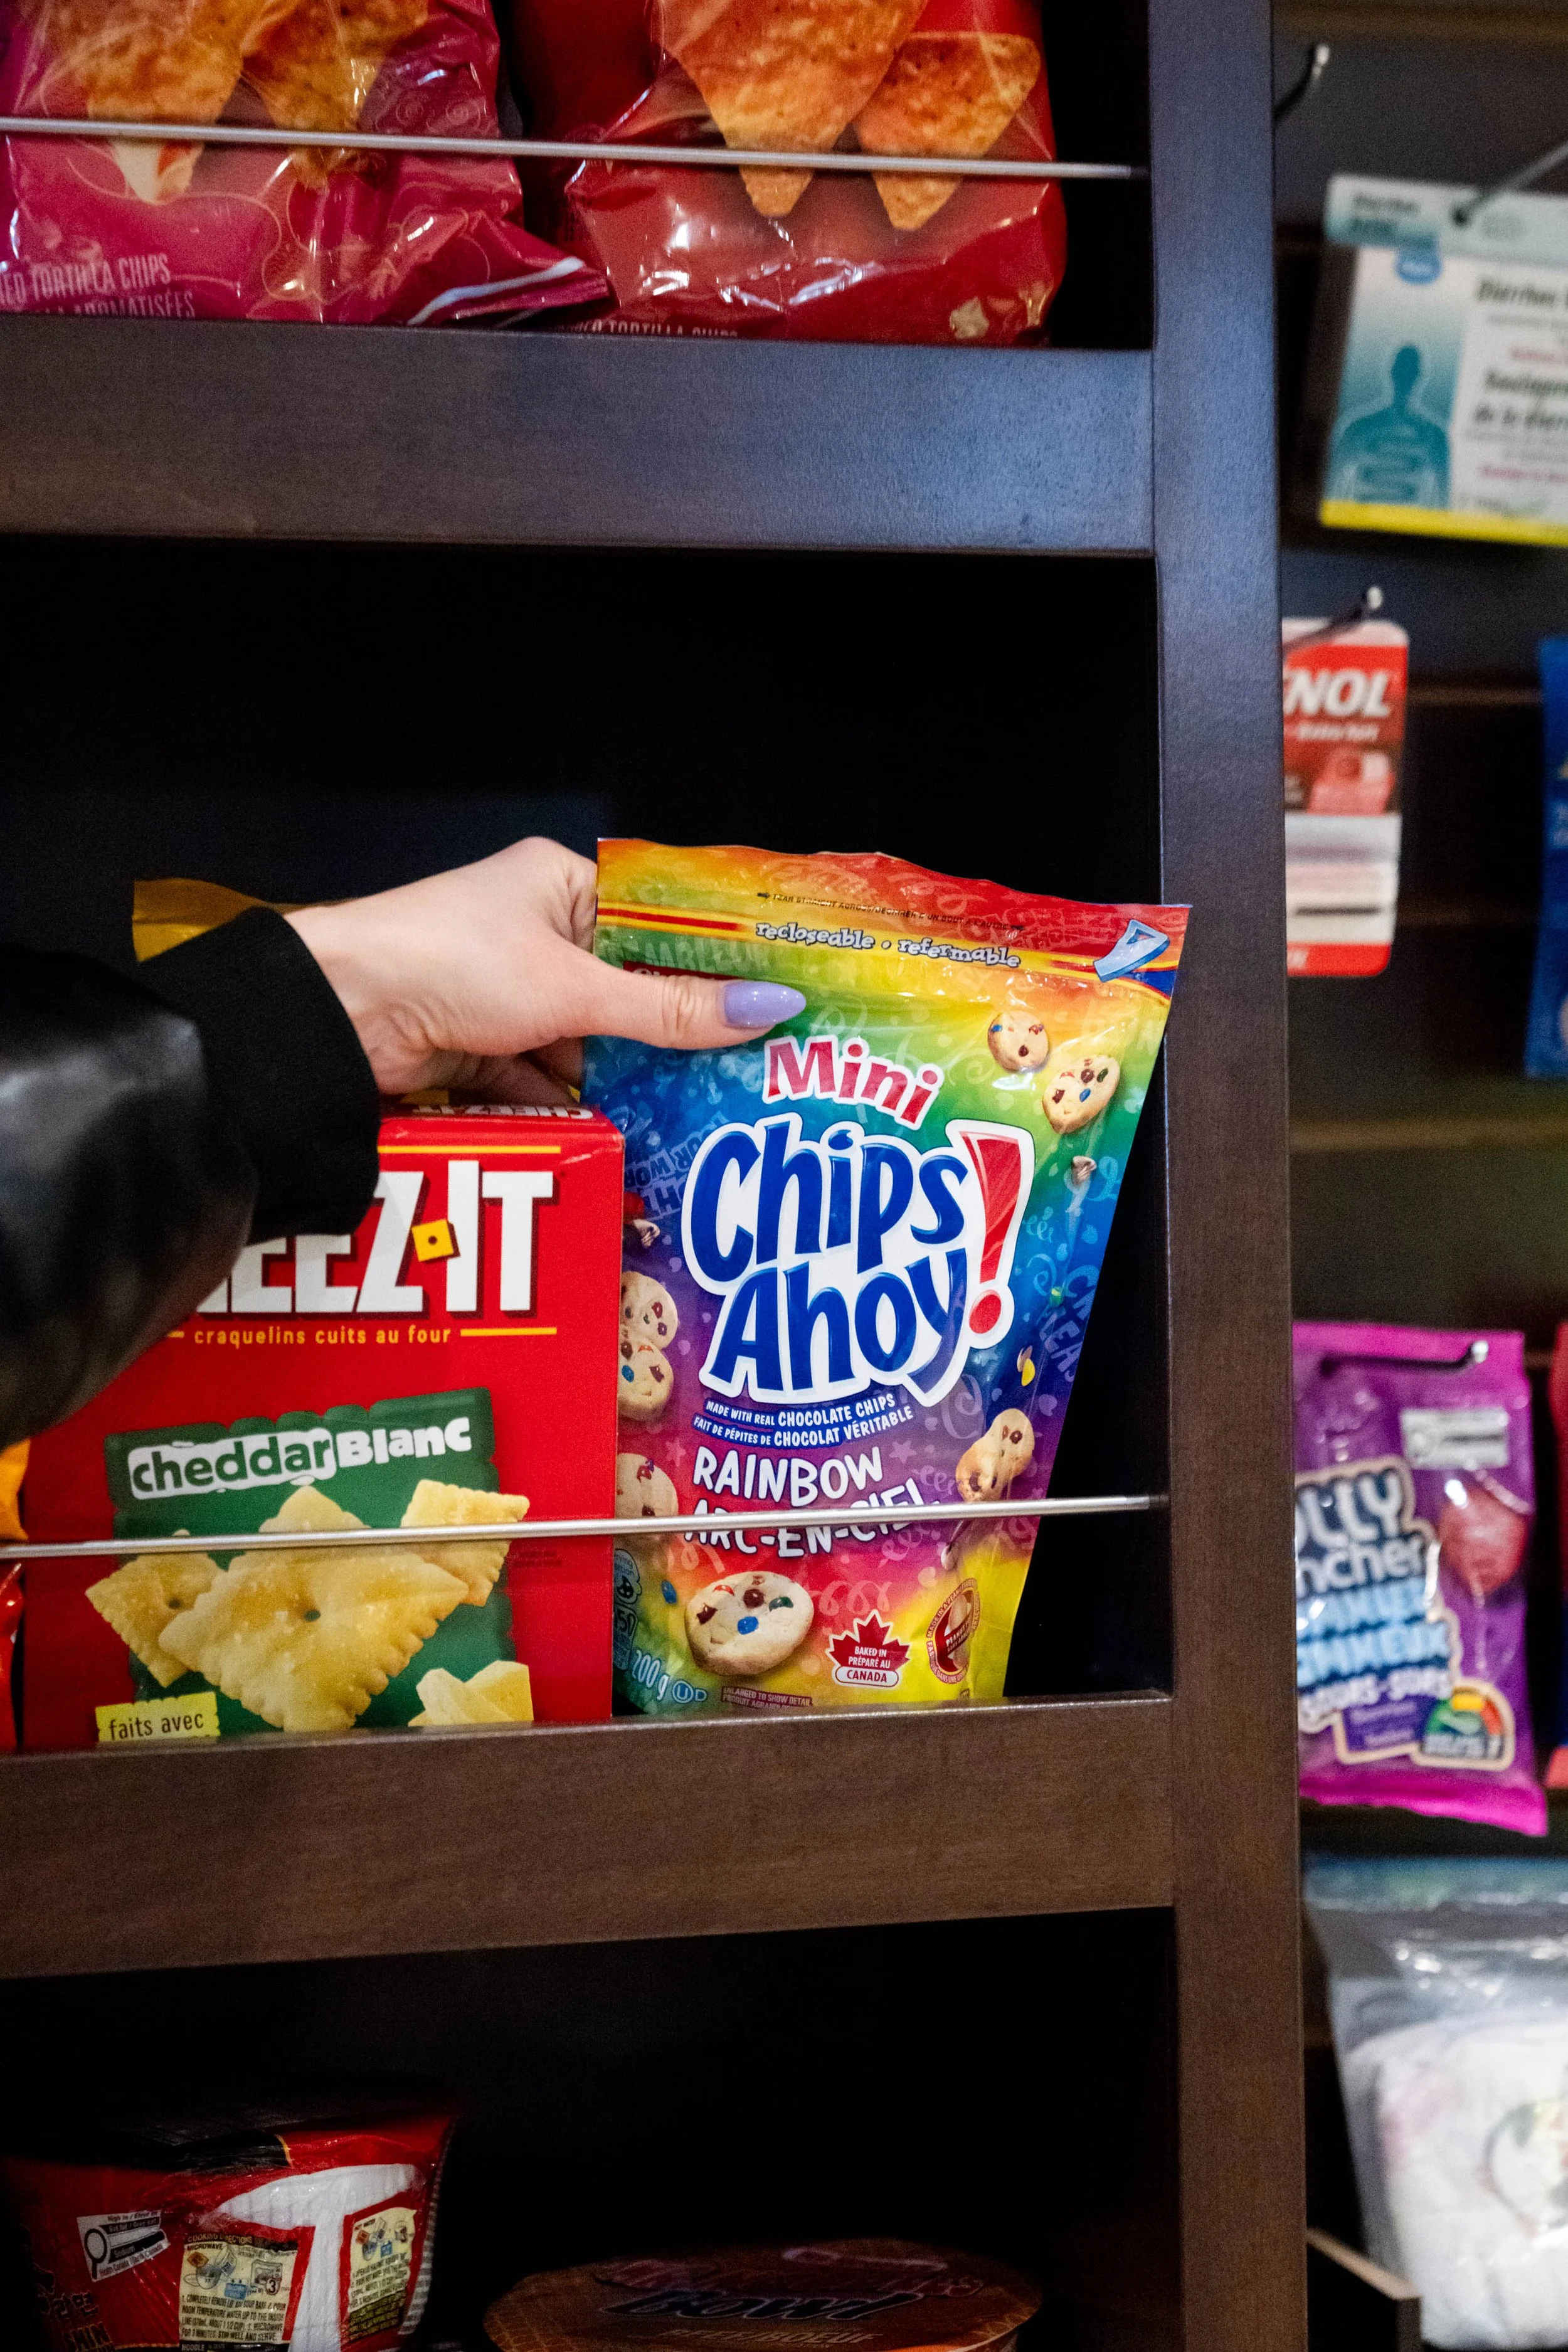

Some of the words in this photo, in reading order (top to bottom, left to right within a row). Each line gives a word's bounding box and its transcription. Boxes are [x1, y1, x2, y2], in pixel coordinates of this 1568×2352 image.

[118, 252, 170, 290] CHIPS
[756, 922, 875, 950] recloseable
[898, 936, 1020, 968] refermable
[765, 1037, 943, 1127] Mini
[690, 1119, 969, 1283] Chips
[194, 1325, 305, 1349] craquelins
[315, 1325, 367, 1344] cuits
[376, 1330, 400, 1344] au
[408, 1324, 451, 1343] four
[705, 1400, 728, 1417] MADE
[731, 1409, 752, 1424] WITH
[754, 1414, 775, 1426] REAL
[778, 1405, 852, 1428] CHOCOLATE
[855, 1393, 896, 1417] CHIPS
[693, 1416, 711, 1432] FAIT
[712, 1424, 723, 1436] DE
[724, 1427, 758, 1444] PÉPITES
[760, 1435, 771, 1446] DE
[773, 1427, 840, 1447] CHOCOLAT
[844, 1406, 914, 1441] VÉRITABLE
[132, 1436, 332, 1493] cheddar
[336, 1417, 472, 1468] Blanc
[692, 1445, 884, 1508] RAINBOW
[848, 1655, 879, 1668] PRÉPARÉ
[880, 1660, 891, 1668] AU
[854, 1646, 878, 1656] BAKED
[879, 1648, 887, 1657] IN
[632, 1650, 661, 1688] 200
[657, 1674, 669, 1700] g
[847, 1669, 887, 1683] CANADA
[723, 1687, 757, 1699] ENLARGED
[758, 1692, 766, 1700] TO
[768, 1694, 788, 1703] SHOW
[789, 1696, 810, 1706] DETAIL
[109, 1717, 152, 1741] faits
[161, 1713, 204, 1734] avec
[188, 2234, 219, 2243] COOKING
[220, 2234, 253, 2245] DECTIONS
[268, 2279, 276, 2294] 3
[242, 2311, 250, 2319] UP
[250, 2312, 257, 2321] TO
[258, 2312, 267, 2321] THE
[245, 2333, 257, 2341] AND
